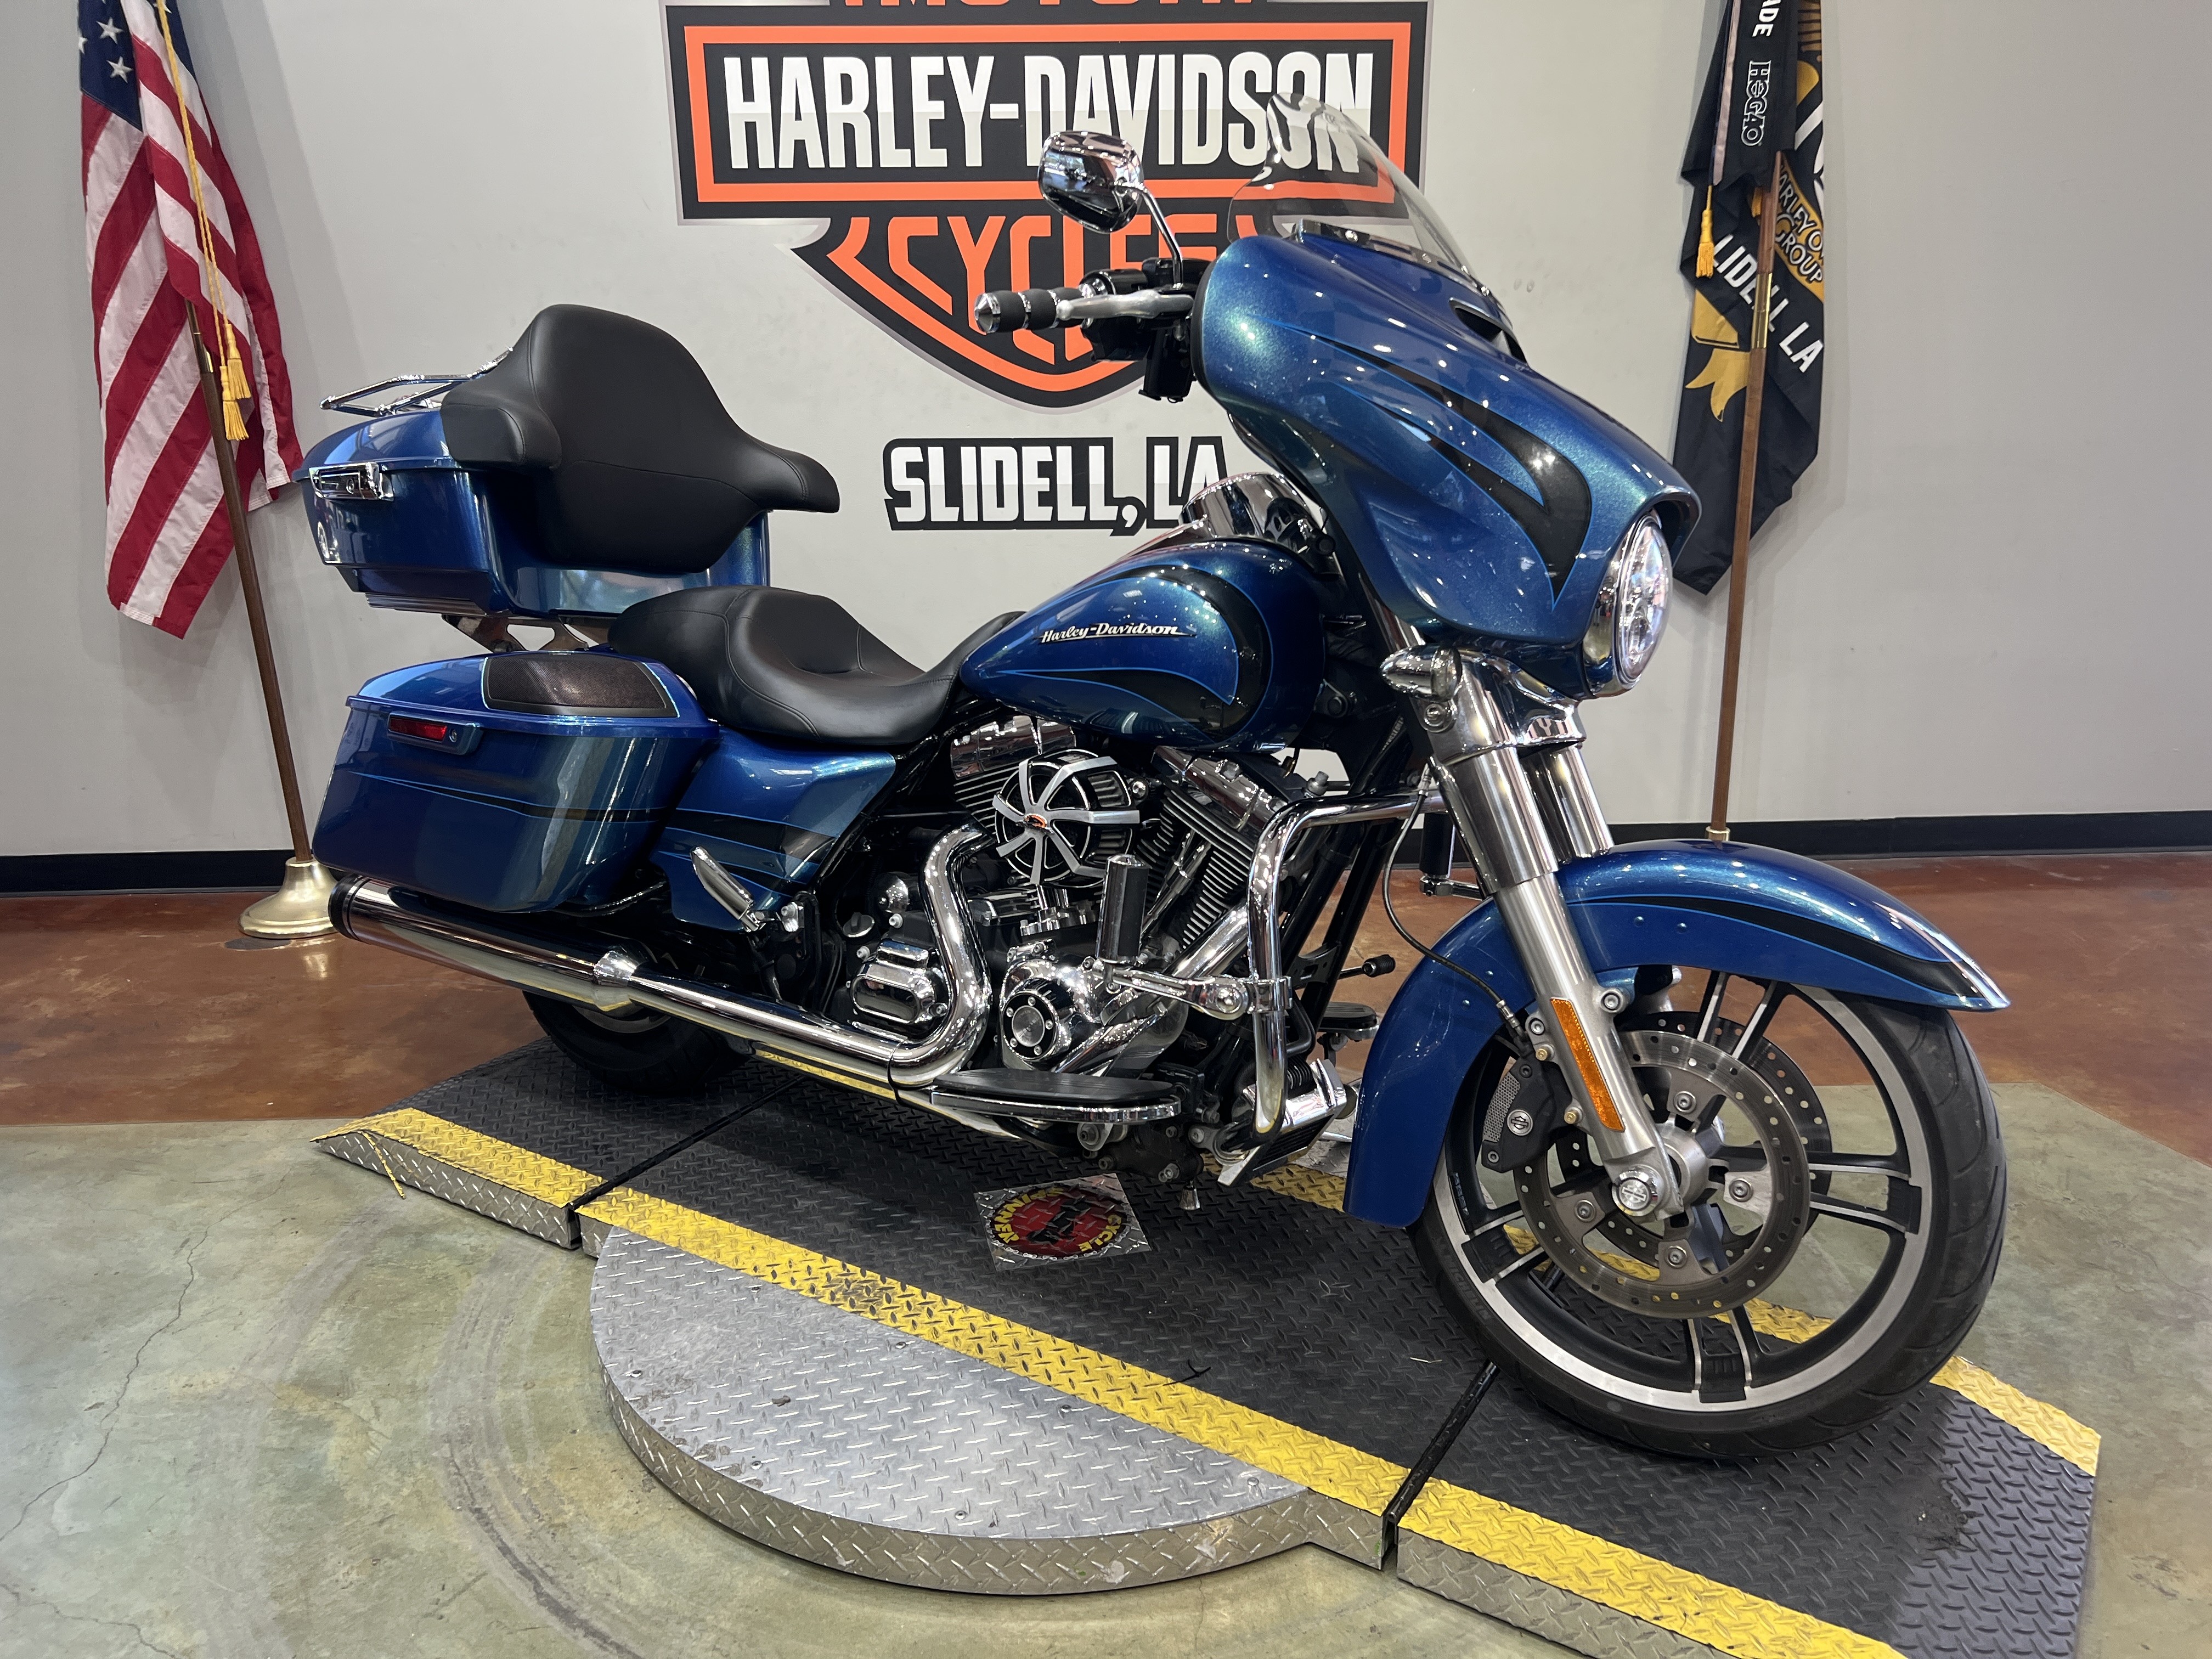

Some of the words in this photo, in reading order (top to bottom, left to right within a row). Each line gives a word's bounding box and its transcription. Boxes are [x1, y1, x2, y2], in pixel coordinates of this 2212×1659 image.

[724, 52, 1373, 169] HARLEY-DAVIDSON
[1779, 171, 1815, 233] ARLEY
[1779, 321, 1824, 373] LA
[1041, 623, 1185, 643] Harley-Davidson
[1077, 1214, 1122, 1252] CYCLE
[1442, 1255, 1491, 1320] MICHELIN
